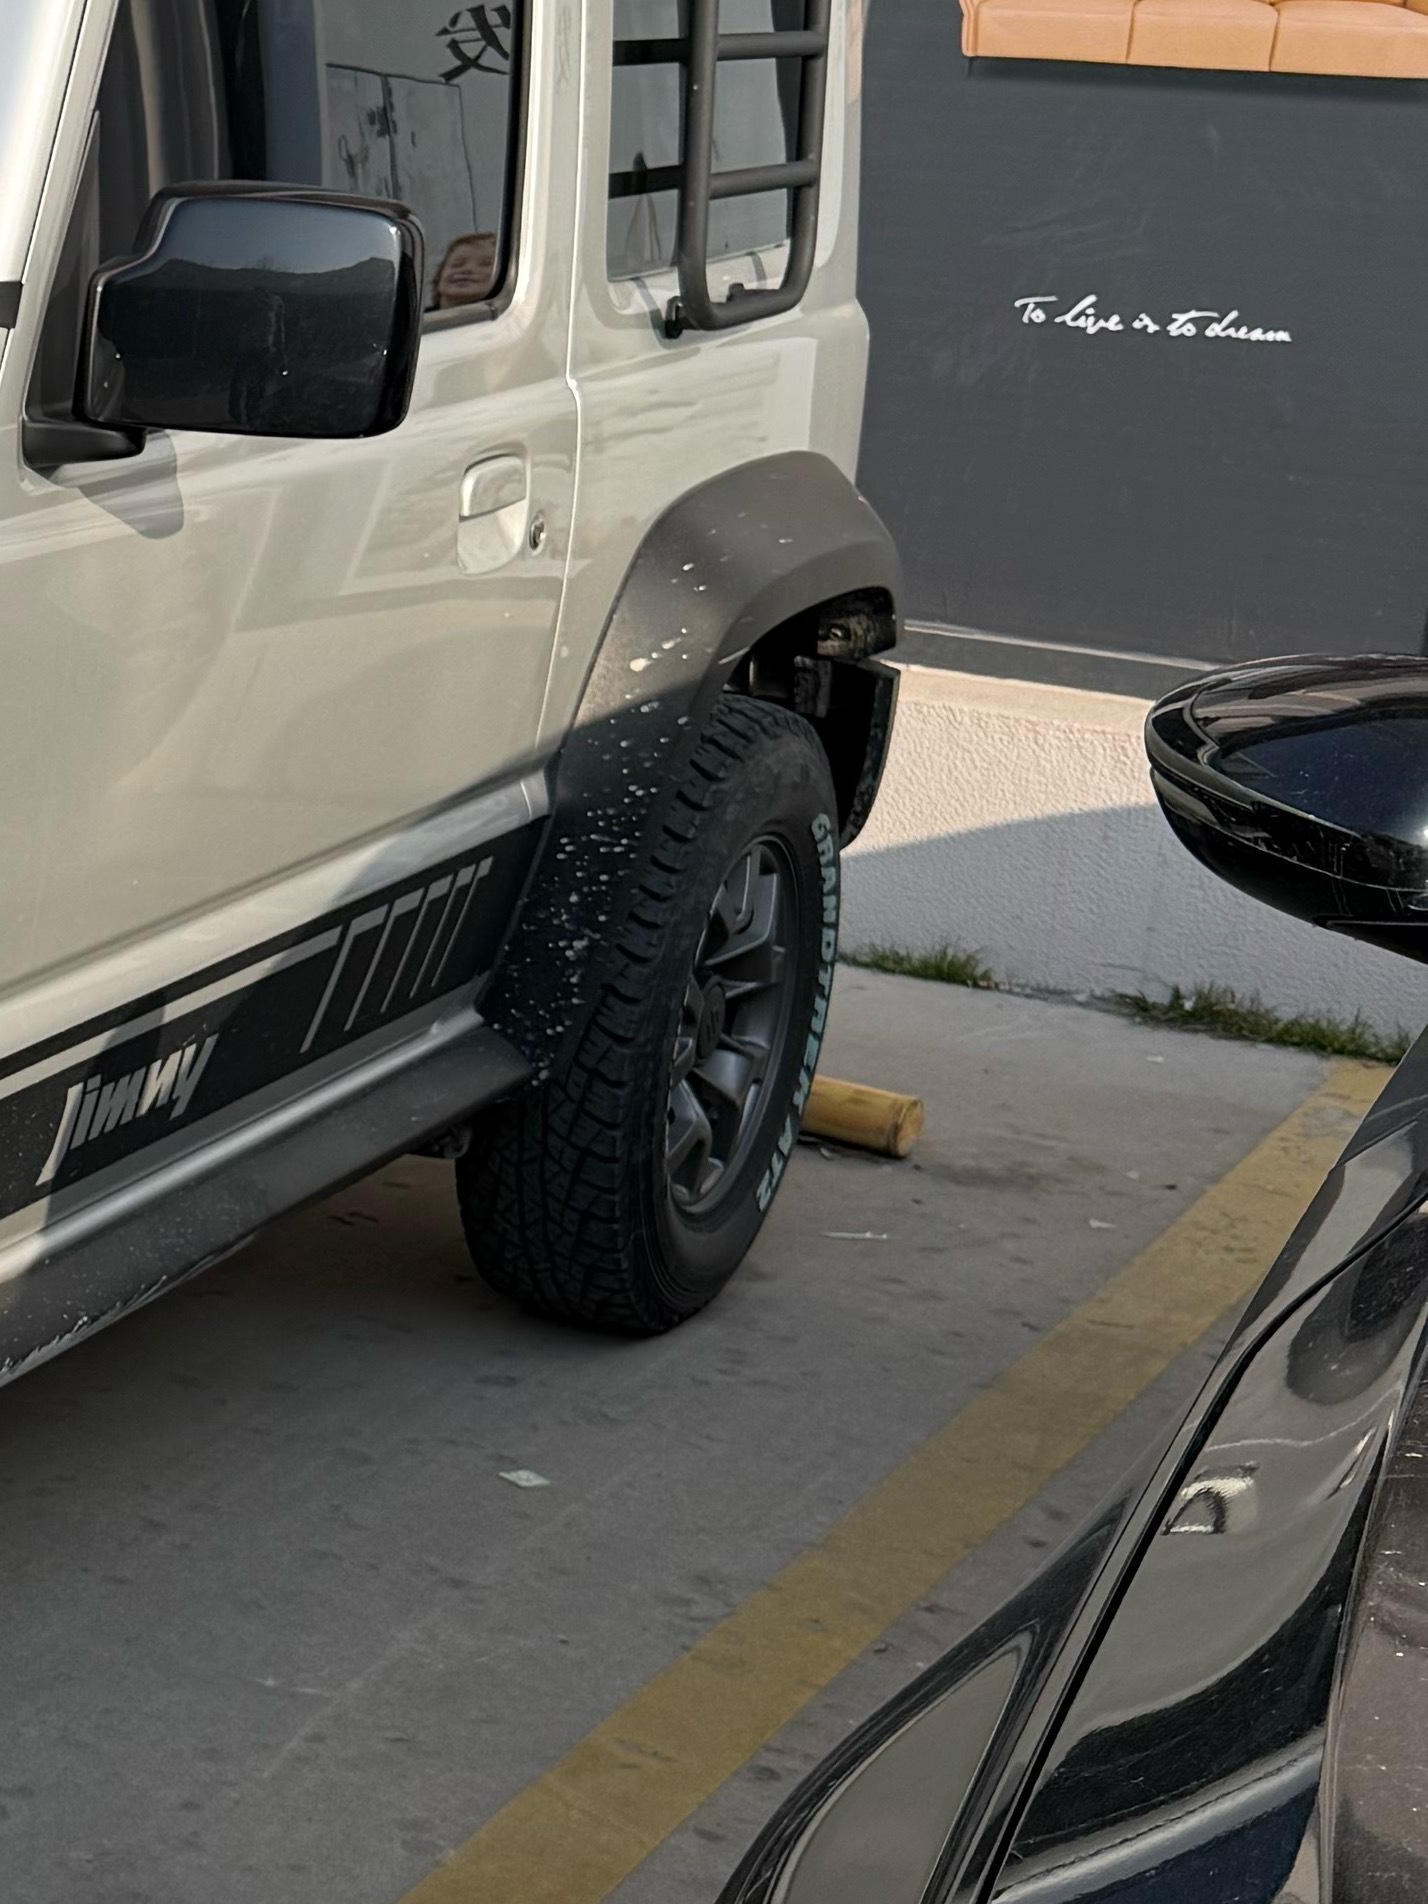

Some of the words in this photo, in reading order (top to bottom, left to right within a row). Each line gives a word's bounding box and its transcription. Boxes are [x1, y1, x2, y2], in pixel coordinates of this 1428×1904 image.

[1014, 295, 1058, 324] To
[1054, 294, 1124, 334] live
[1167, 309, 1220, 337] to
[1204, 309, 1292, 343] dream
